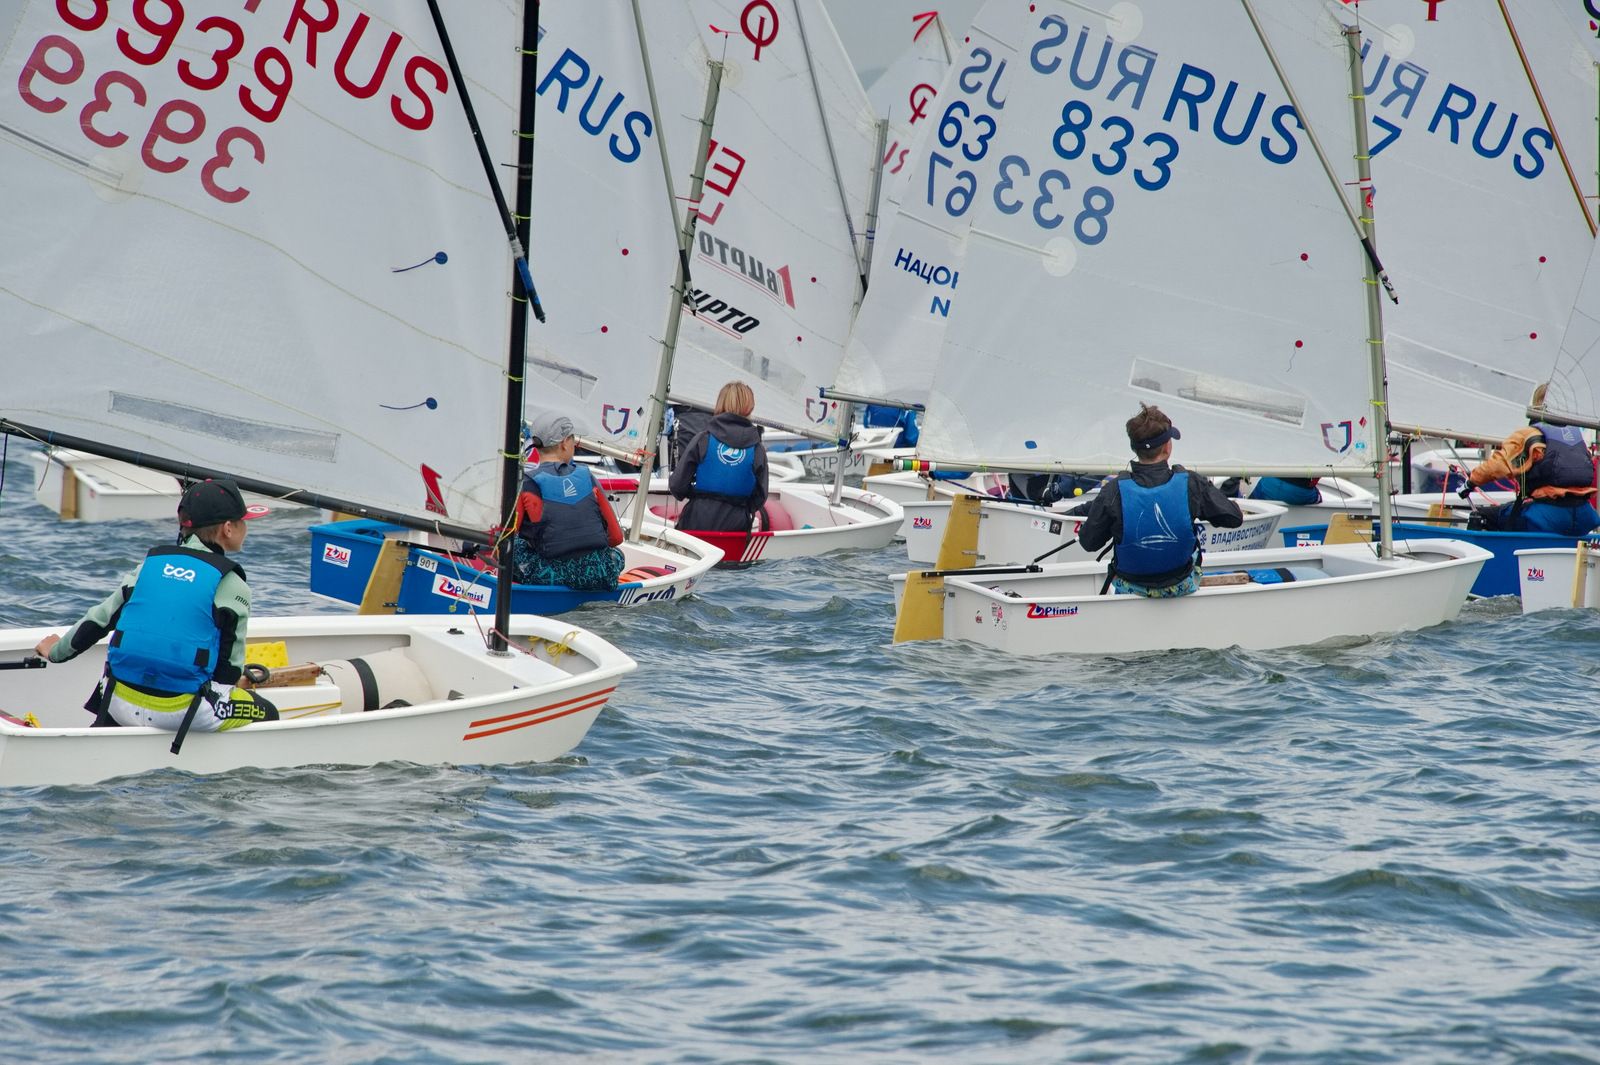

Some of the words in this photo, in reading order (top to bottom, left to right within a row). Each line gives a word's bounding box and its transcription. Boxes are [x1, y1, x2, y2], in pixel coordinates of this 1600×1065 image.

[283, 0, 449, 131] RUS
[535, 47, 653, 163] RUS
[1162, 62, 1306, 165] RUS
[937, 99, 997, 162] 63
[1052, 99, 1180, 192] 833
[1427, 82, 1555, 180] RUS
[419, 558, 436, 570] 901
